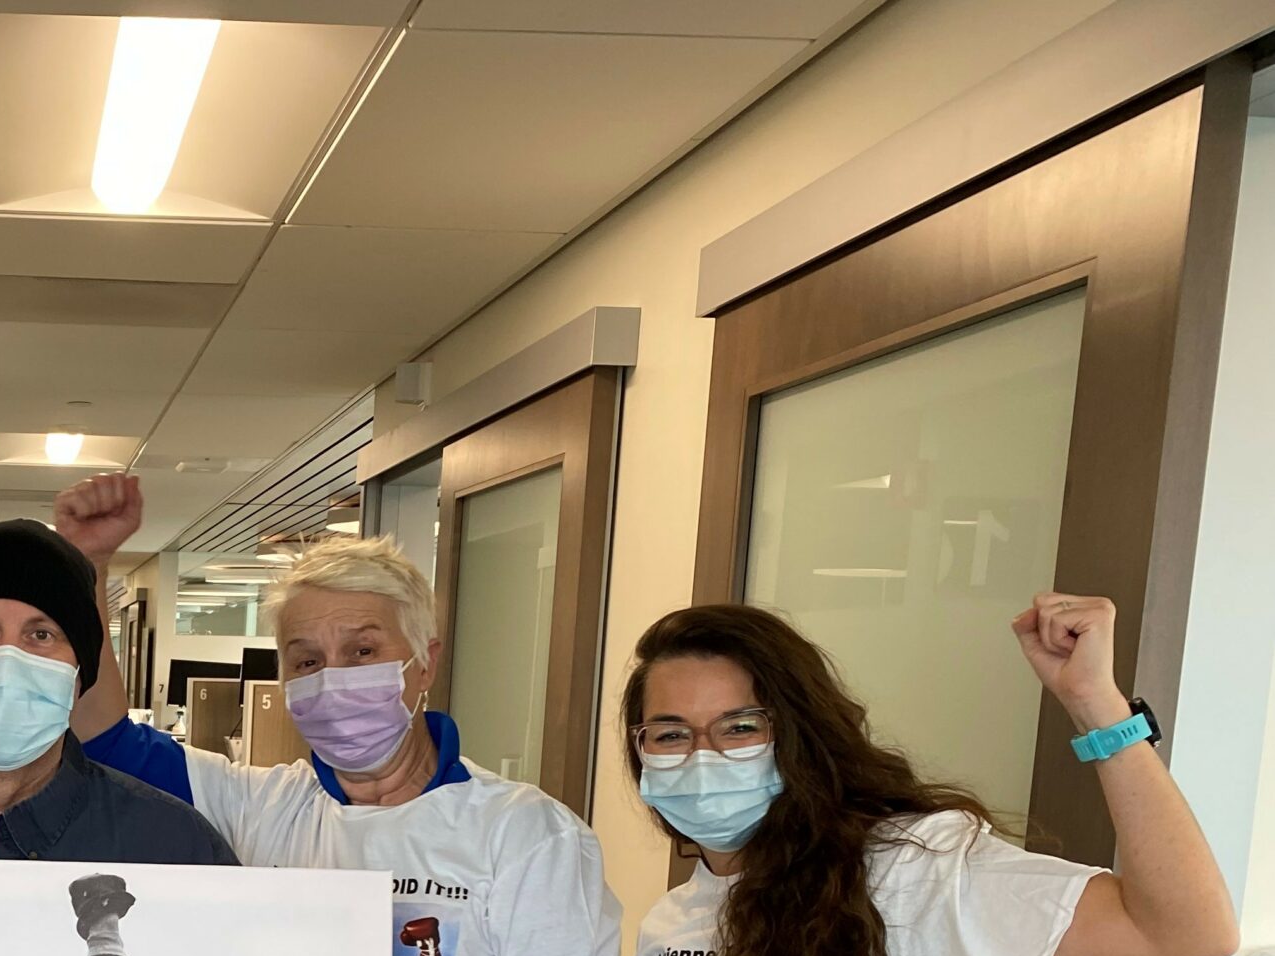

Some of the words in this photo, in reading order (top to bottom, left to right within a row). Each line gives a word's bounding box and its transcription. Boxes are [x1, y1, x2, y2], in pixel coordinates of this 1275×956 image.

[158, 683, 165, 694] 7
[199, 688, 208, 701] 6
[261, 694, 272, 710] 5
[425, 879, 469, 900] IT!!!
